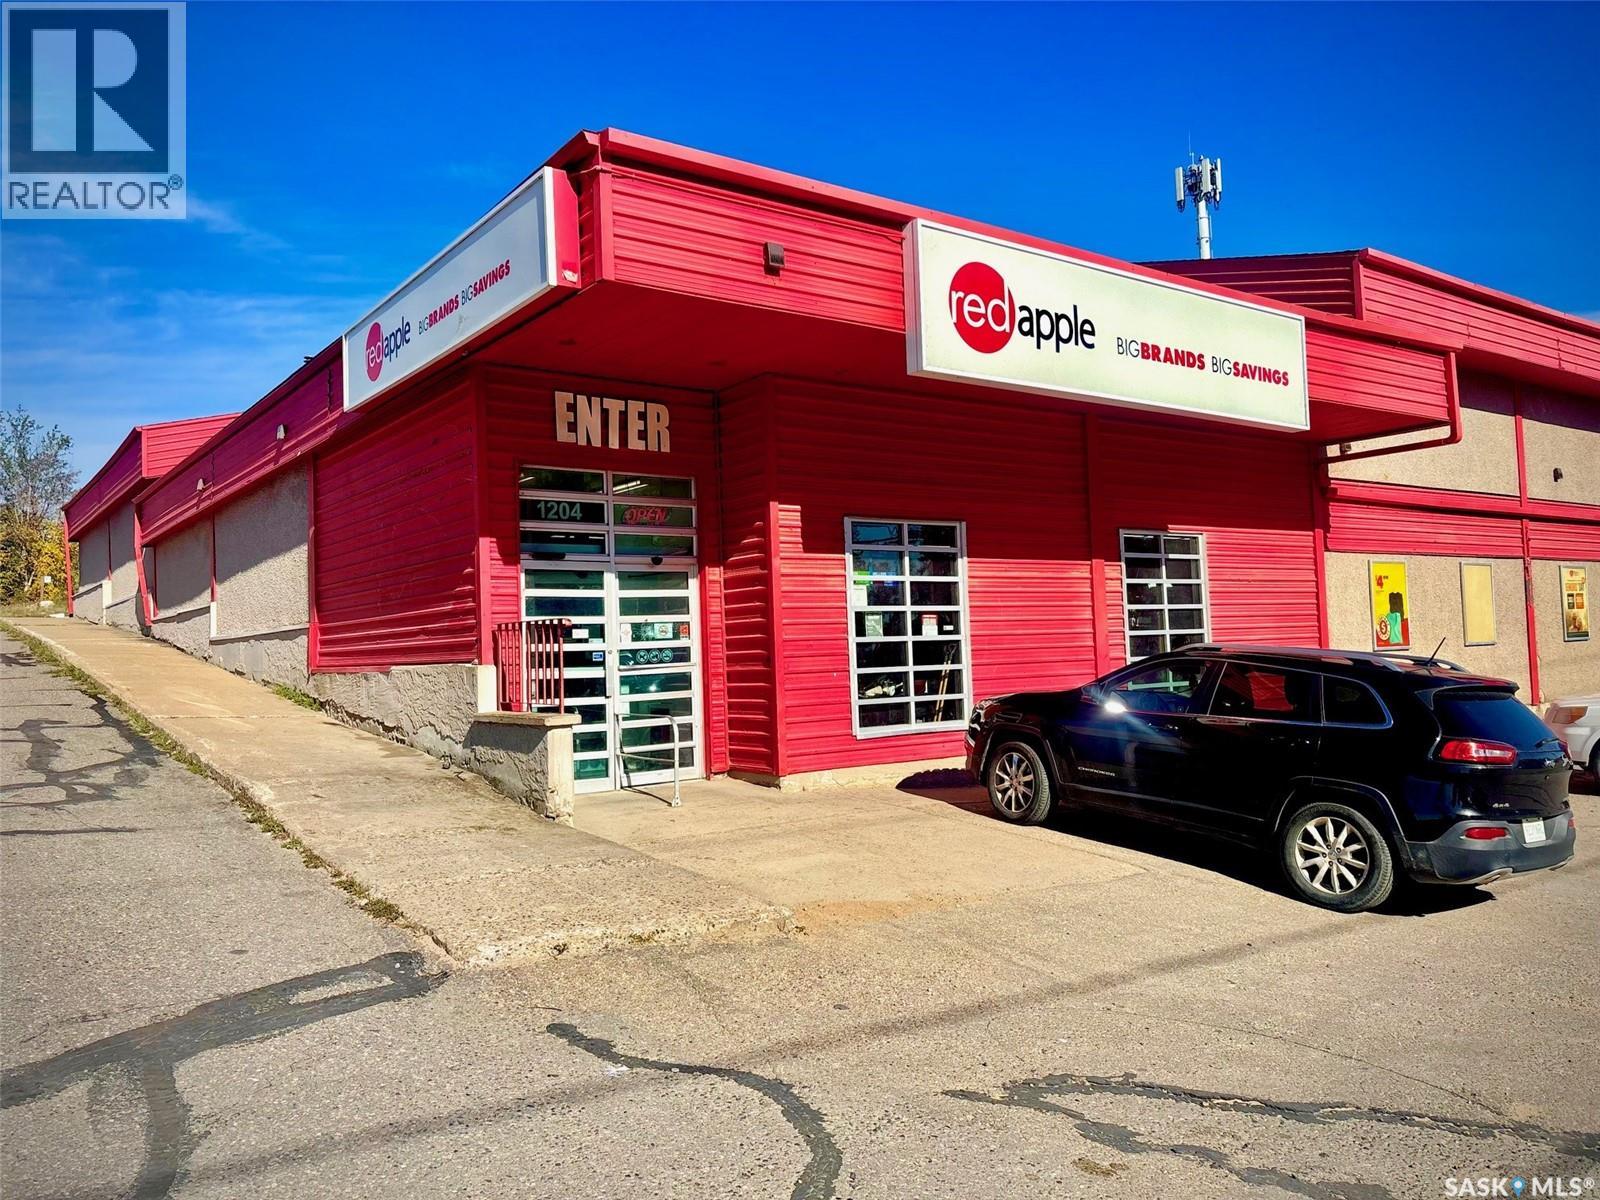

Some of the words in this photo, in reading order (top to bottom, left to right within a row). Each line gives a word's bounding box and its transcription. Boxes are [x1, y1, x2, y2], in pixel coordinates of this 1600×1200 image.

[951, 277, 1011, 333] red
[1017, 304, 1096, 353] apple
[366, 330, 384, 367] red
[384, 316, 411, 362] apple
[554, 390, 671, 453] ENTER
[536, 501, 582, 520] 1204
[623, 507, 668, 525] OPEN
